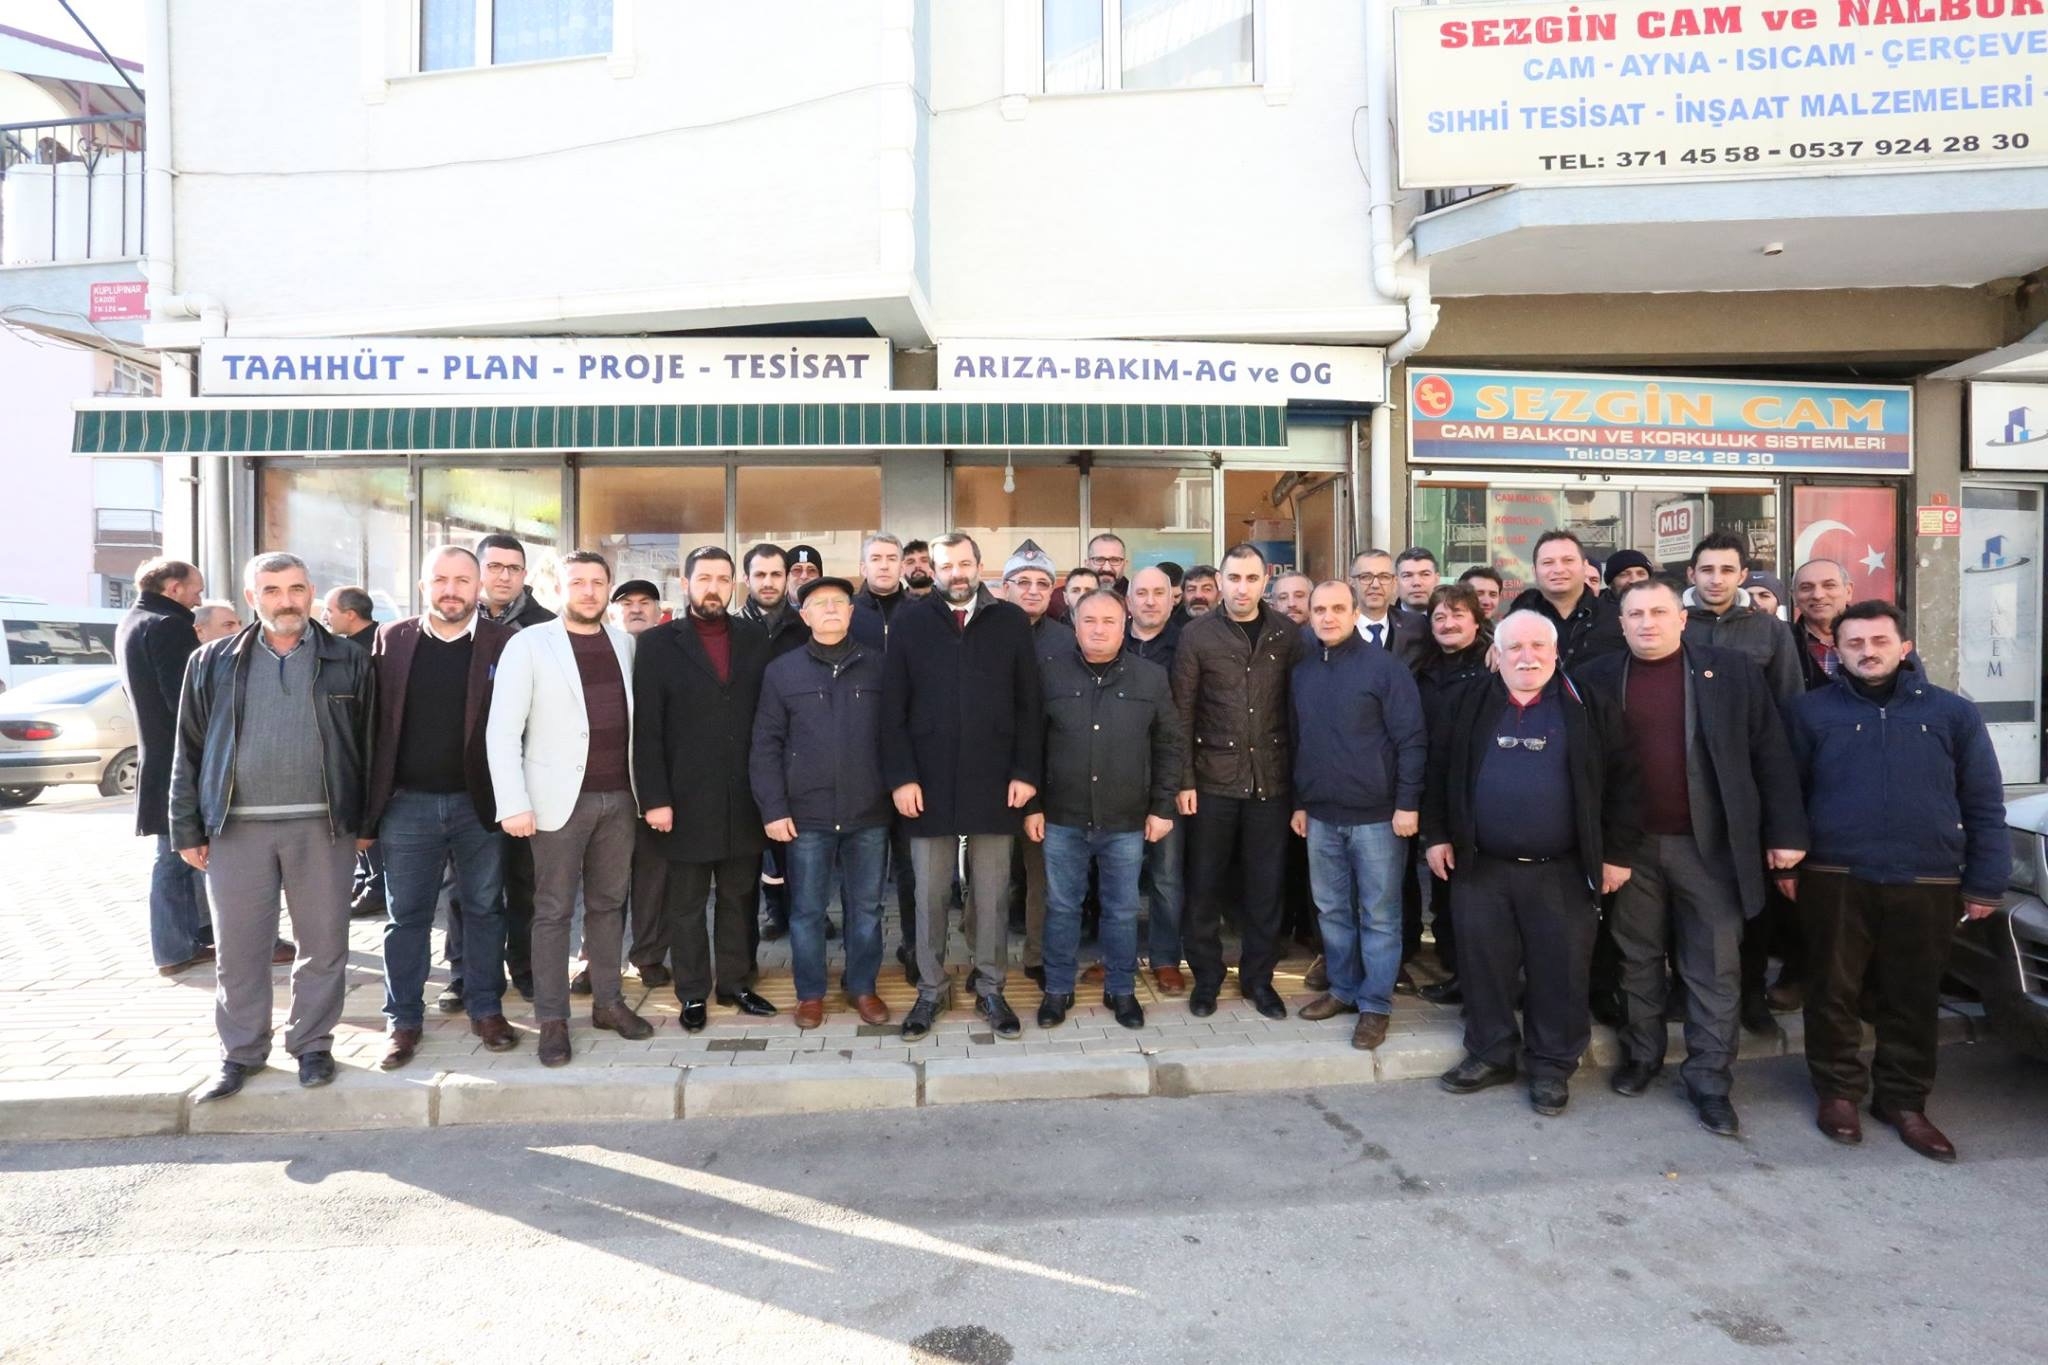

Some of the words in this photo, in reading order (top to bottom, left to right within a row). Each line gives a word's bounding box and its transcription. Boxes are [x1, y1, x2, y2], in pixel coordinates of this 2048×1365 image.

[1439, 6, 1617, 49] SEZGİN
[1637, 6, 1743, 39] CAM
[1761, 7, 1818, 31] ve
[1523, 55, 1596, 81] CAM
[1619, 50, 1712, 77] AYNA
[1735, 42, 1857, 72] ISICAM
[1881, 29, 2048, 69] ÇERÇEVE
[1428, 100, 1509, 134] SIHHİ
[1519, 97, 1647, 130] TESİSAT
[1675, 92, 1790, 128] İNŞAAT
[1800, 74, 2033, 118] MALZEMELERİ
[1539, 154, 1605, 171] TEL:
[1615, 150, 1667, 168] 371
[1680, 148, 1717, 165] 45
[1724, 146, 1760, 163] 58
[1789, 141, 1864, 159] 0537
[1875, 138, 1932, 156] 924
[1943, 135, 1980, 153] 28
[1991, 132, 2030, 150] 30
[222, 348, 405, 381] TAAHHÜT
[443, 354, 538, 381] PLAN
[579, 354, 685, 384] PROJE
[724, 346, 870, 379] TESİSAT
[954, 356, 1236, 383] ARIZA-BAKIM-AG
[1248, 366, 1279, 382] ve
[1290, 362, 1332, 385] OG
[1476, 383, 1714, 424] SEZGİN
[1741, 396, 1886, 430] CAM
[1440, 424, 1495, 440] CAM
[1502, 426, 1597, 444] BALKON
[1604, 430, 1634, 443] VE
[1641, 431, 1758, 448] KORKULUK
[1664, 450, 1706, 463] 924
[1712, 452, 1740, 464] 28
[1747, 452, 1774, 465] 30
